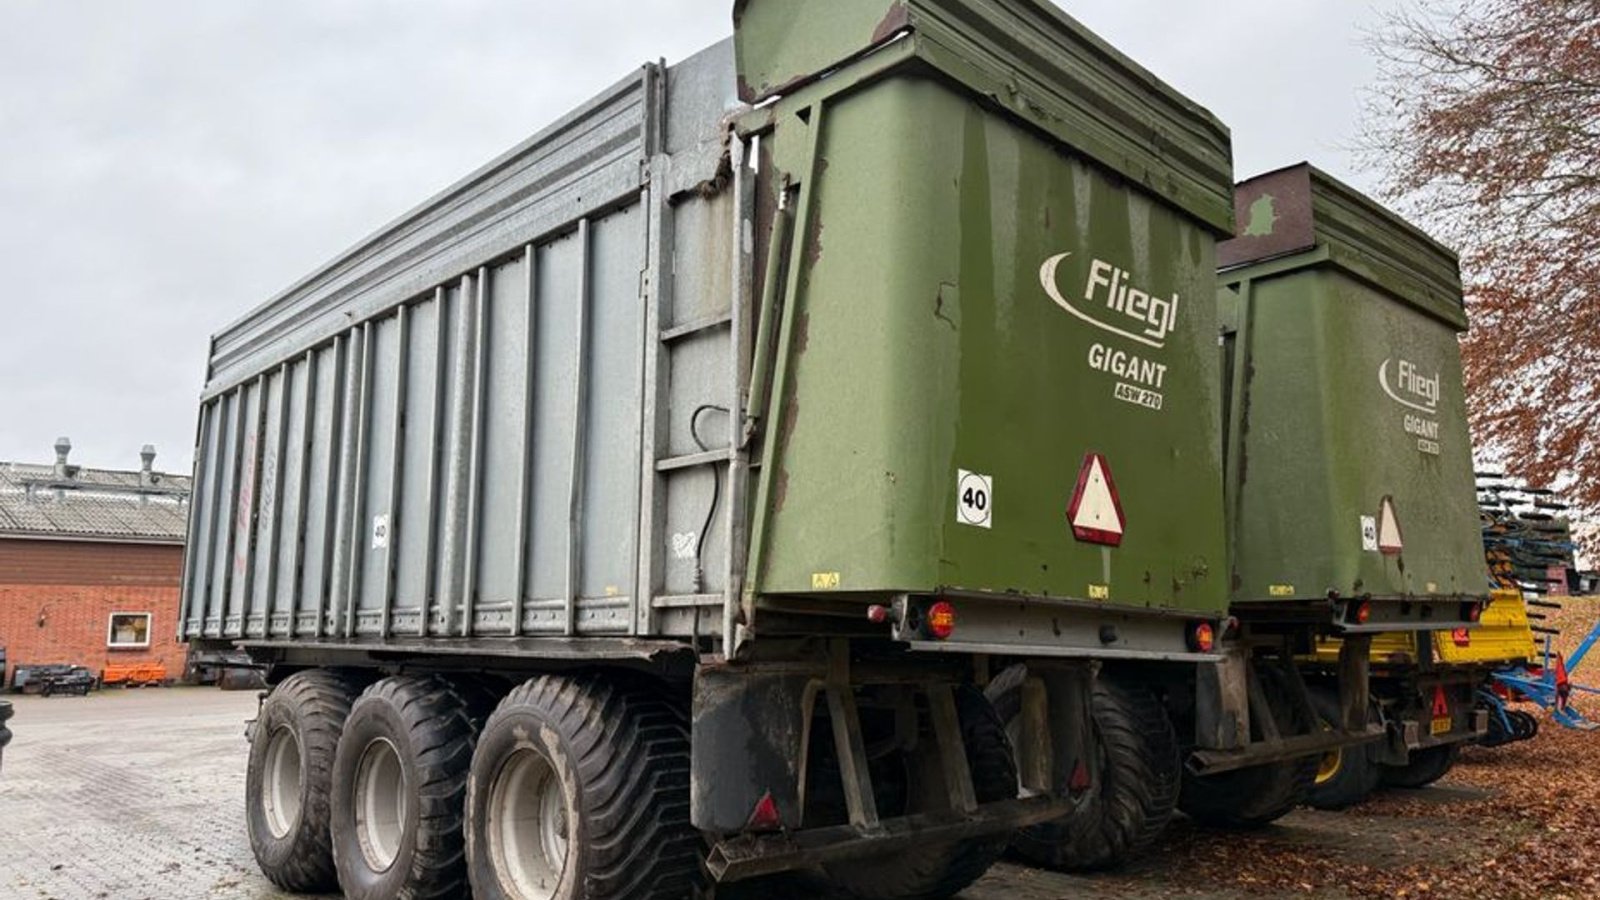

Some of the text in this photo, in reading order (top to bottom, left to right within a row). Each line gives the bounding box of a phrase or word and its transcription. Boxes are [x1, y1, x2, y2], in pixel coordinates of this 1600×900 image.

[1085, 259, 1179, 339] Fliegl
[1088, 343, 1167, 388] GIGANT
[1116, 383, 1161, 409] ASW 270
[1399, 360, 1440, 407] Fliegl
[1404, 414, 1440, 439] GIGANT
[963, 487, 987, 511] 40
